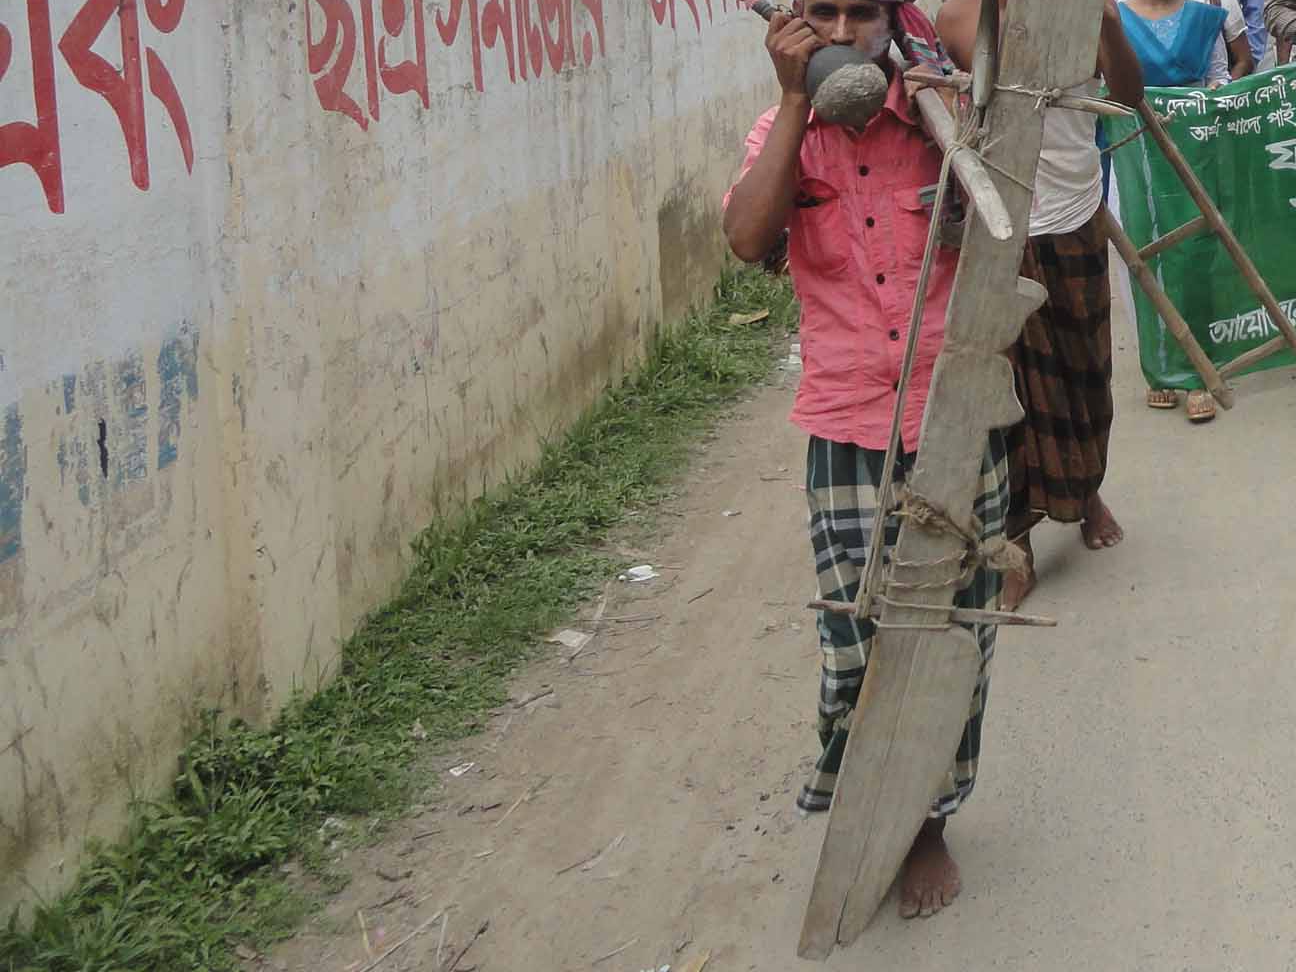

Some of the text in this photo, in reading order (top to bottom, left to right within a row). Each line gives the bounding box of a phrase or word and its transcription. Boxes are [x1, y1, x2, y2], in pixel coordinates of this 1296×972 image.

[1214, 92, 1250, 112] ফলে
[1255, 75, 1286, 105] বেশী
[1266, 102, 1296, 127] পাই
